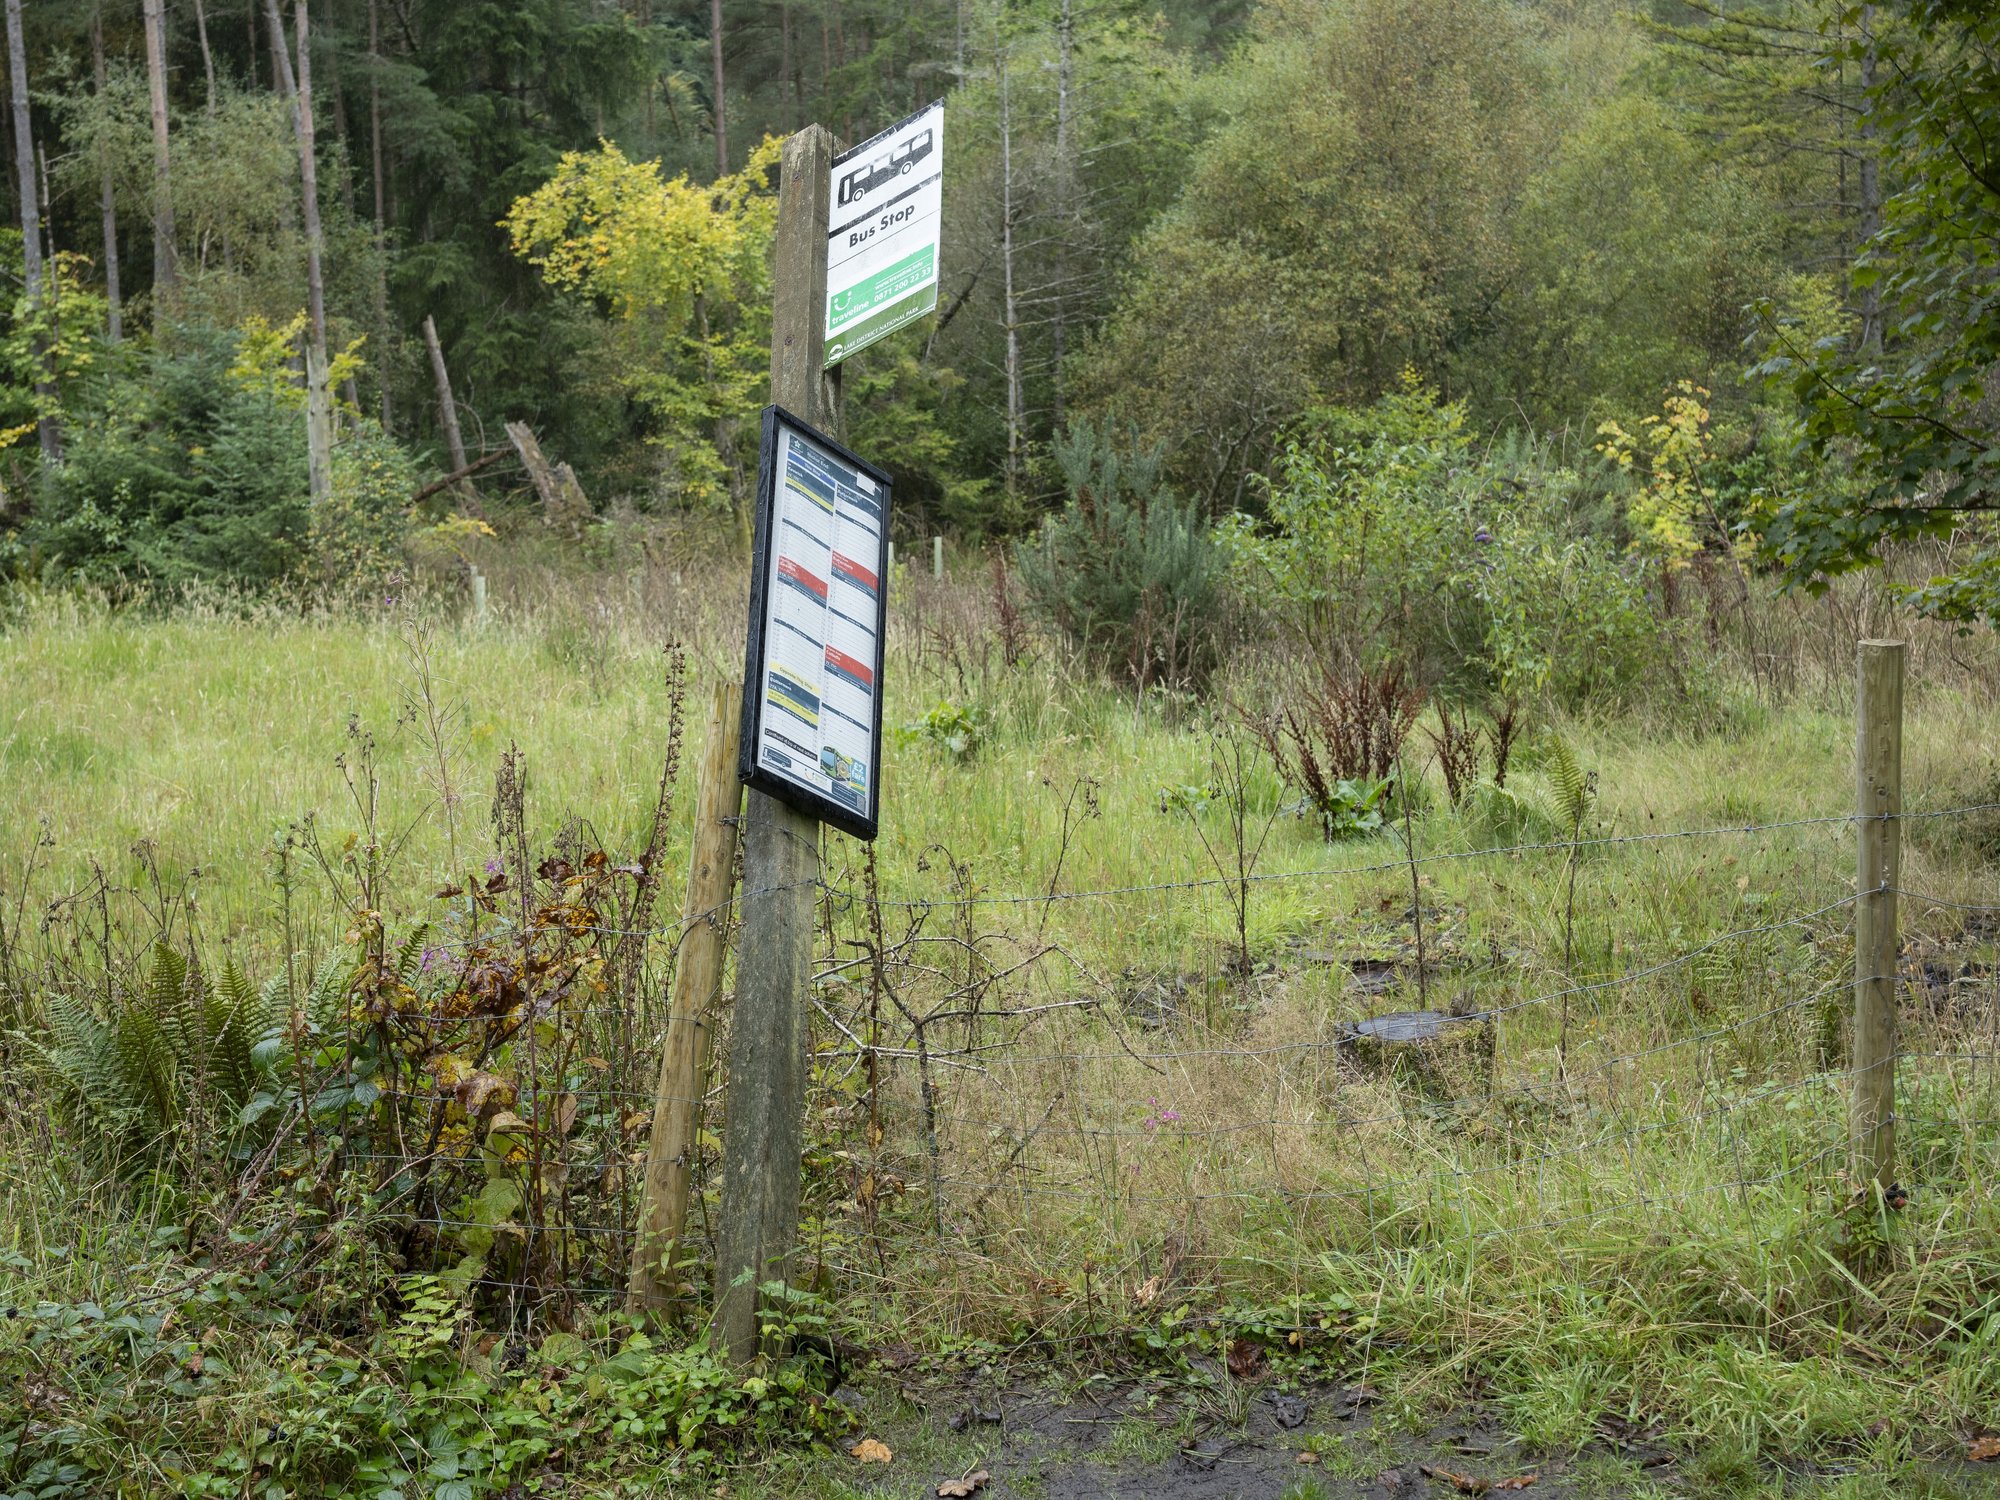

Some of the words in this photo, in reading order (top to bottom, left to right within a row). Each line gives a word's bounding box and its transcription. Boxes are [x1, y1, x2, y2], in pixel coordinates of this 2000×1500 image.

[849, 227, 875, 248] Bus
[880, 204, 915, 231] Stop
[873, 289, 892, 302] 0871
[894, 280, 909, 291] 200
[910, 273, 920, 284] 22
[921, 266, 932, 278] 33
[831, 300, 870, 325] traveline
[843, 340, 856, 351] LAKE
[856, 328, 879, 343] DISTRICT
[880, 314, 905, 331] NATIONAL
[905, 306, 919, 318] PARK
[851, 769, 865, 784] fare
[853, 761, 864, 775] £2
